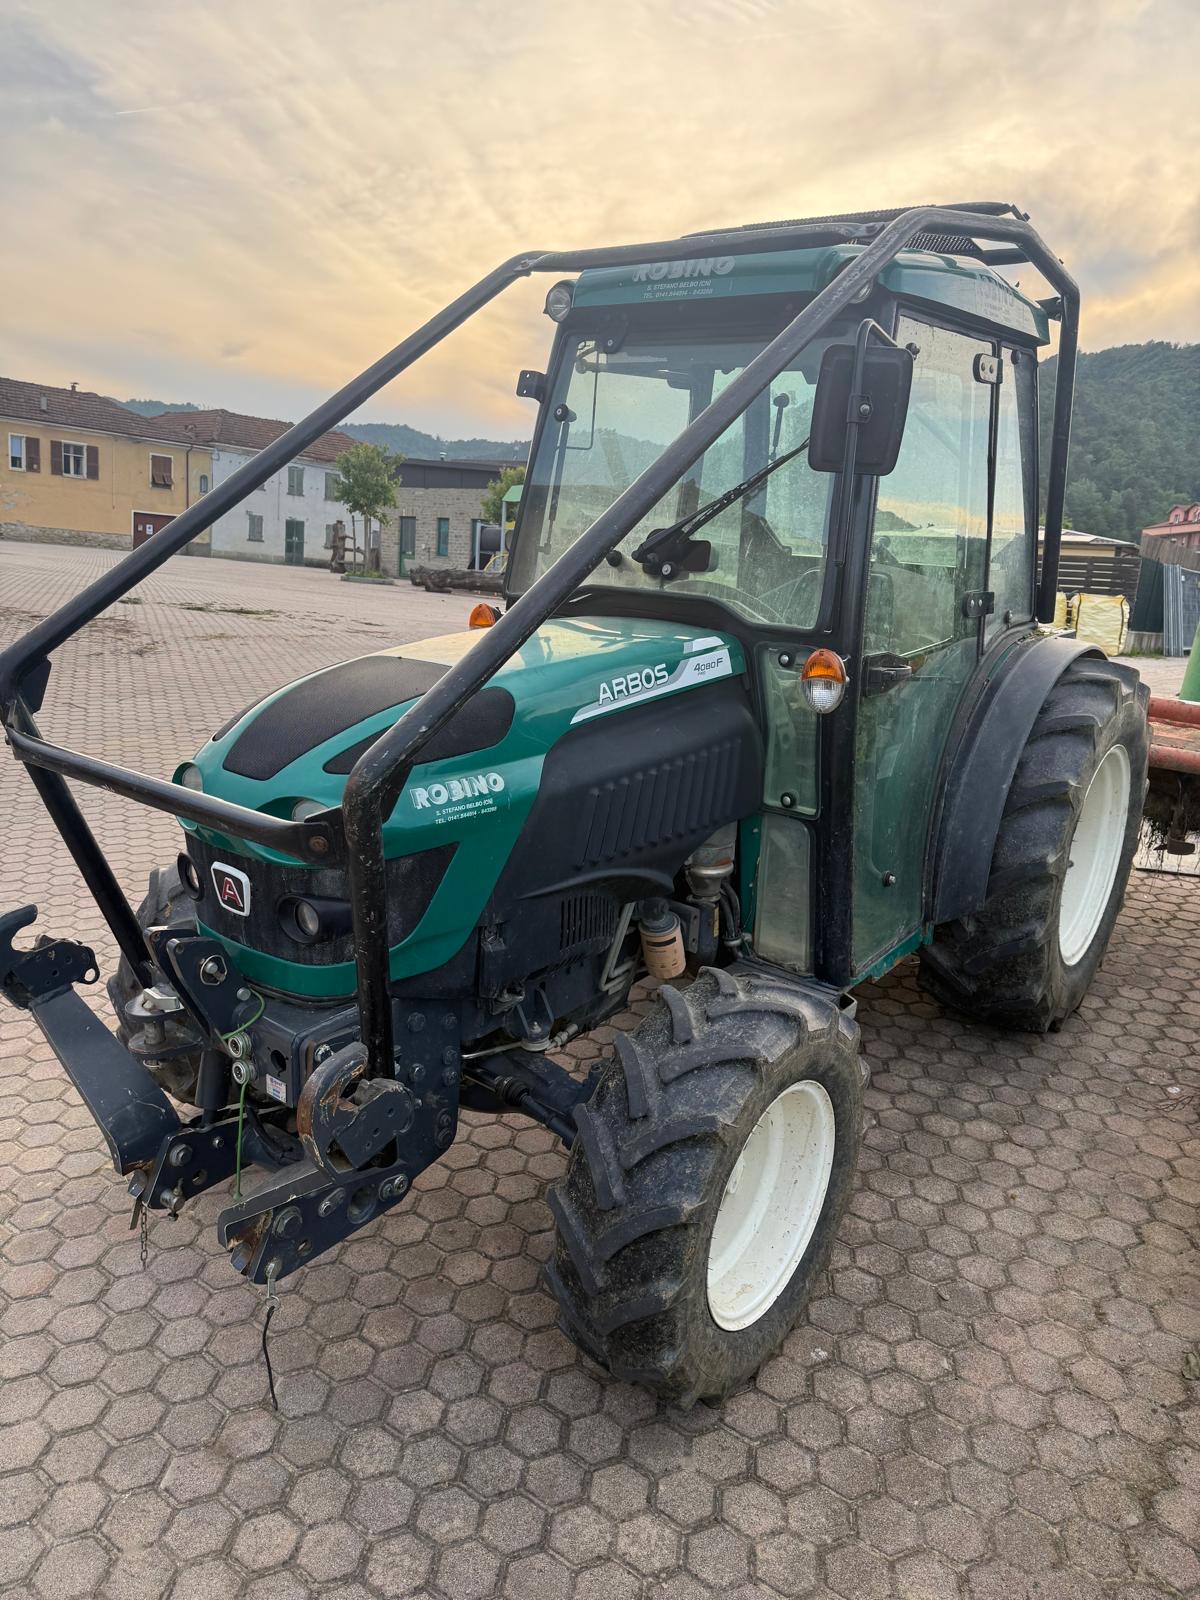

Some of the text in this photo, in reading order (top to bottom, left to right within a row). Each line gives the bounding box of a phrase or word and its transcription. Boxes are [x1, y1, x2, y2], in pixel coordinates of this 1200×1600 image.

[598, 663, 669, 705] ARBOS
[410, 772, 505, 810] ROBINO
[442, 804, 466, 815] STEFANO
